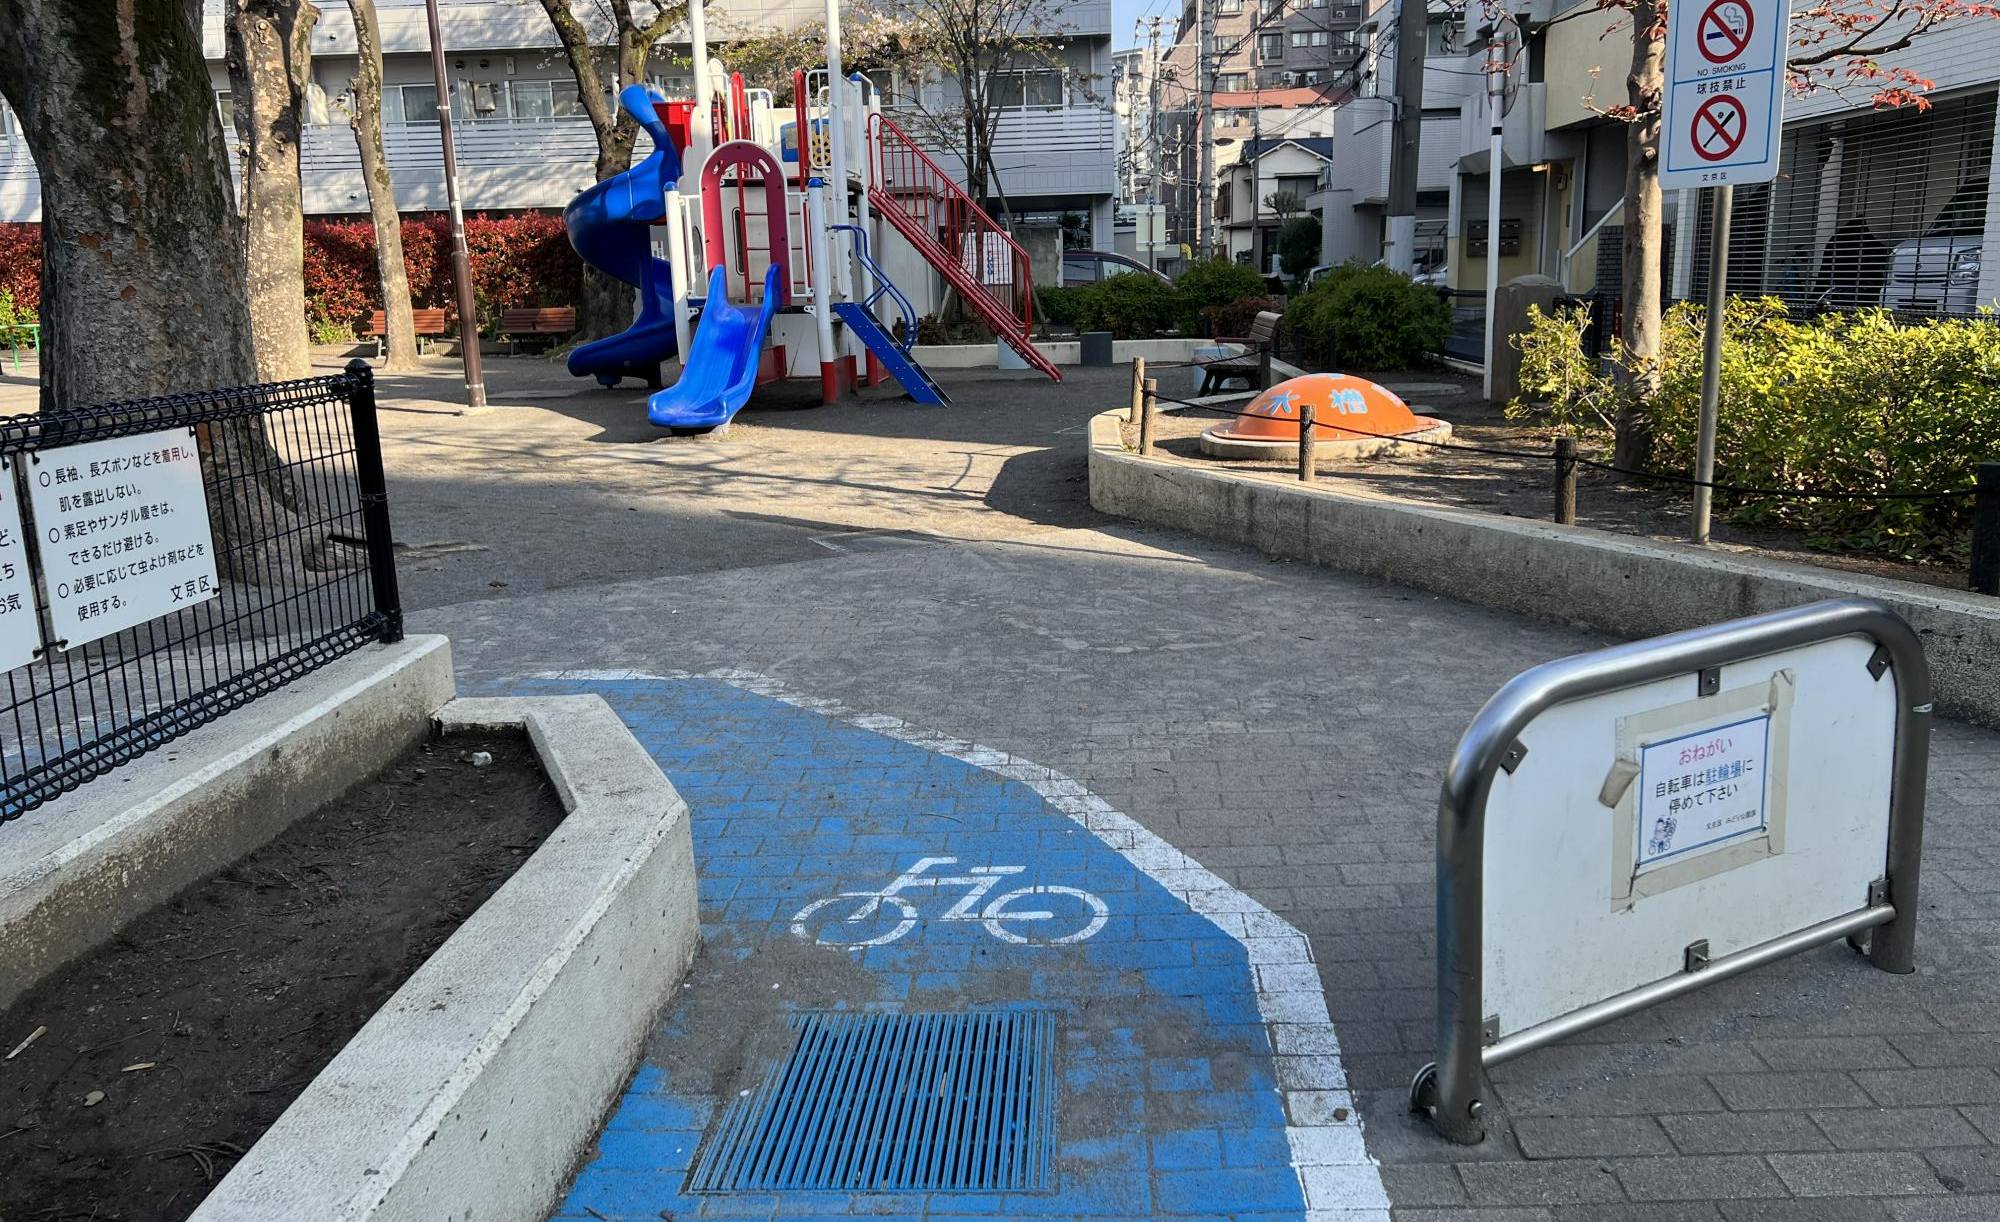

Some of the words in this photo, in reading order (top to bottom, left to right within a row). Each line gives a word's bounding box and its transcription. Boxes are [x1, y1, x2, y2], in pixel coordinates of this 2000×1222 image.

[1697, 68, 1708, 77] NO
[1712, 63, 1746, 75] SMOKING
[1696, 77, 1746, 95] 球技禁止
[1701, 172, 1727, 182] 文京区
[59, 483, 142, 513] 肌を露出しない。
[69, 532, 160, 566] できるだけ避ける。
[170, 575, 211, 602] 文京区
[78, 595, 127, 622] 使用する。
[1679, 738, 1733, 766] おねがい
[1655, 759, 1753, 798] 自転車は駐輪場に
[1669, 784, 1739, 815] 停めて下さい
